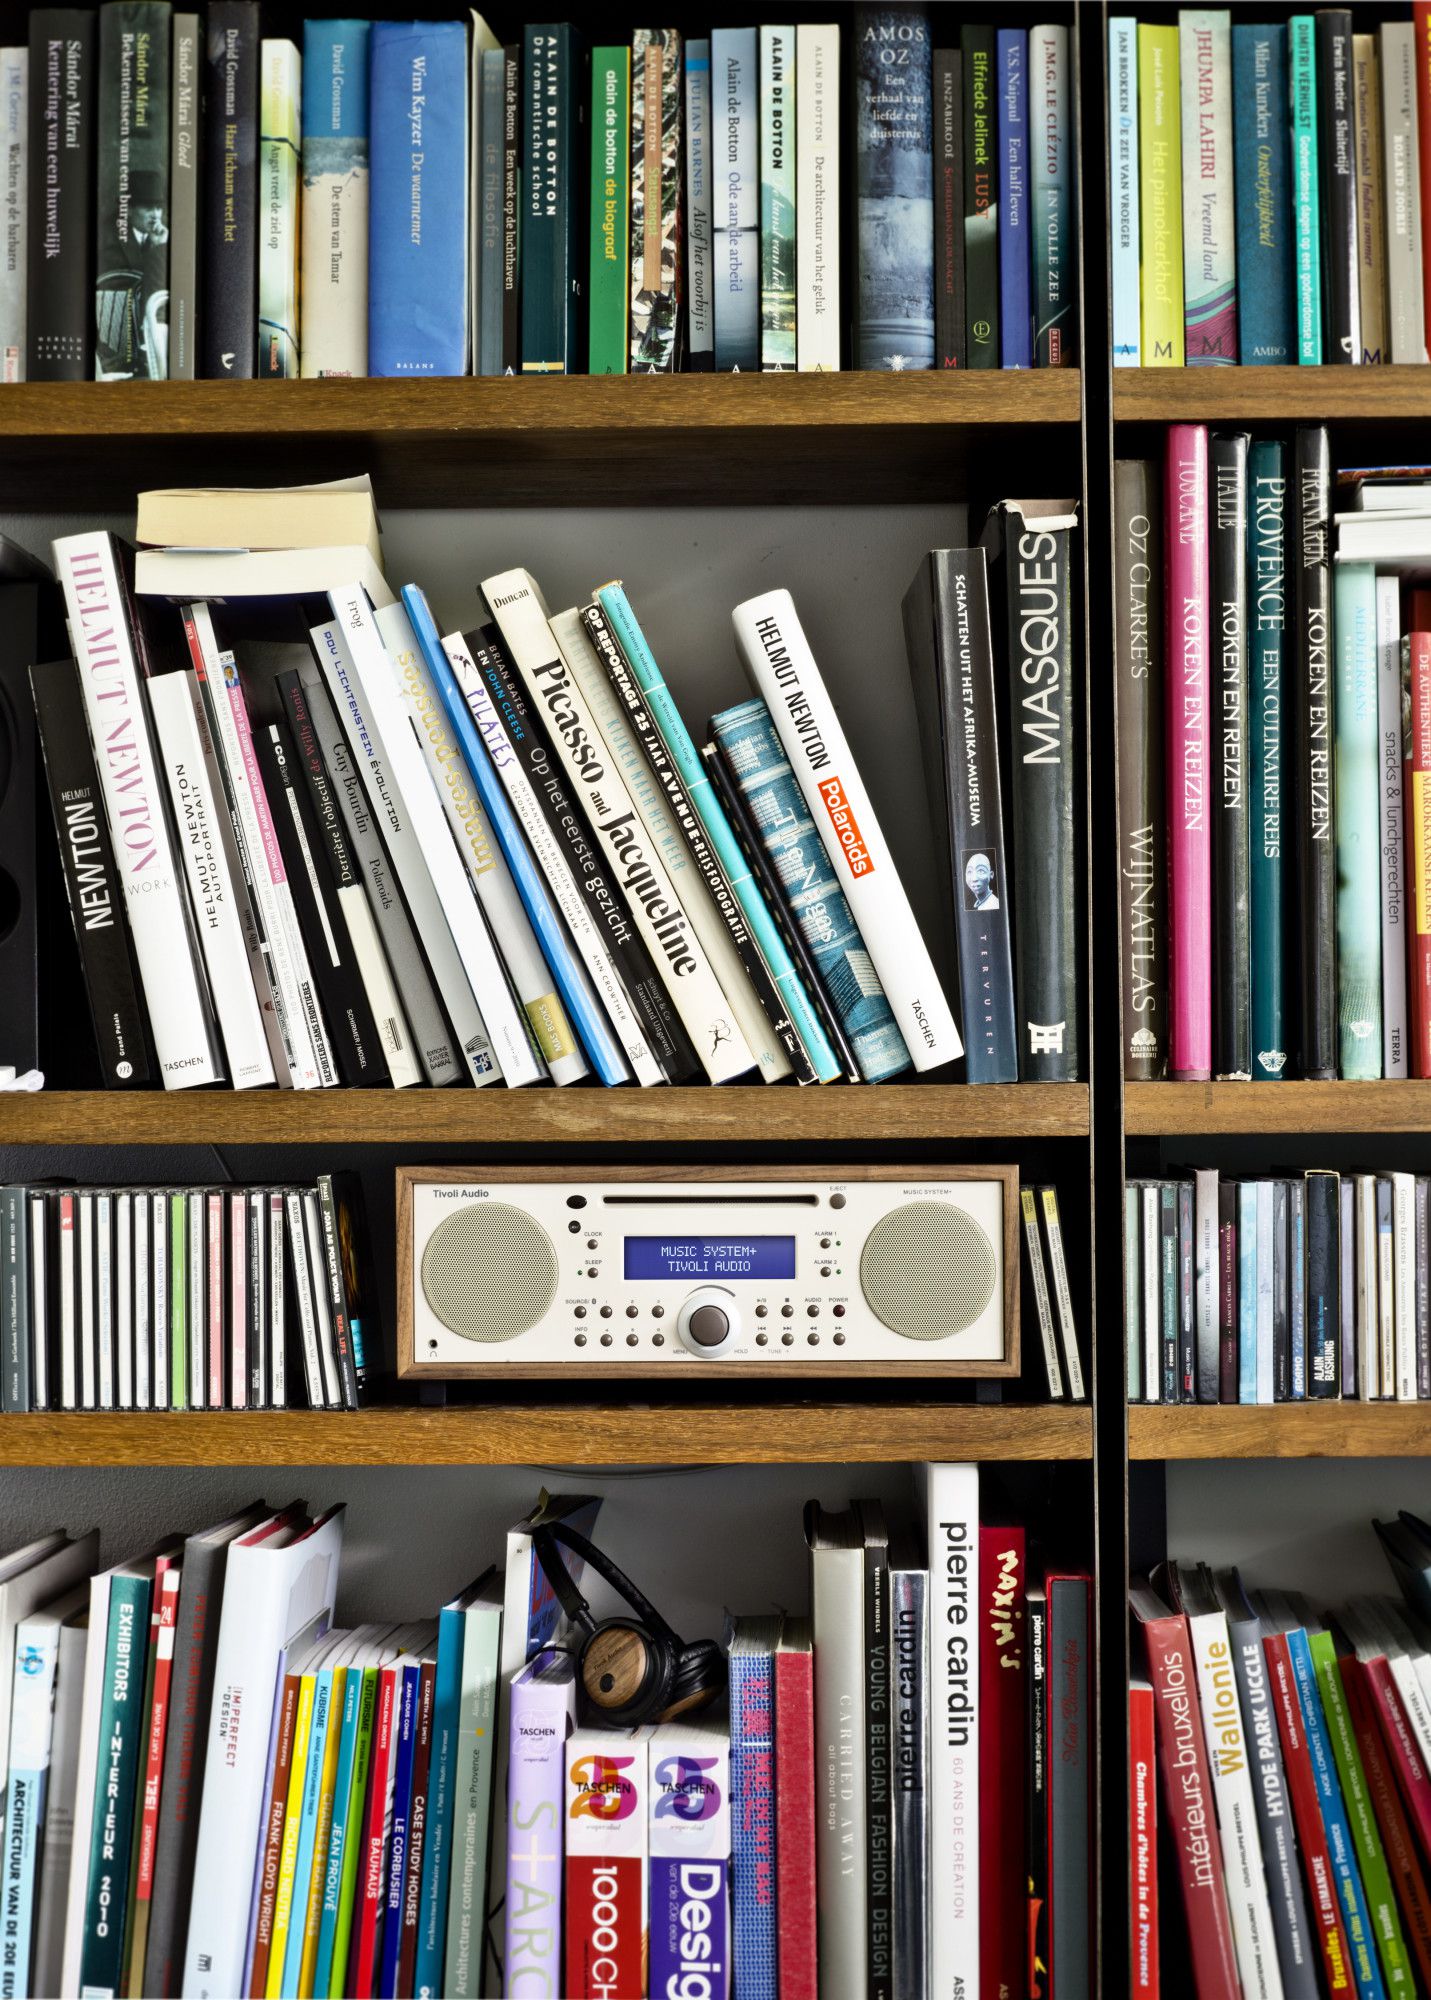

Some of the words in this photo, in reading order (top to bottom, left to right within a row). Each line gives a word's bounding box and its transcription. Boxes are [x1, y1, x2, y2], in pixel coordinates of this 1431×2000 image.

[332, 44, 344, 73] David
[533, 37, 543, 55] De
[863, 26, 924, 41] AMOS
[880, 49, 909, 64] OZ
[1007, 46, 1020, 69] V.S.
[46, 40, 62, 119] Kentering
[66, 40, 81, 98] Sándor
[178, 37, 191, 85] Sándor
[412, 56, 426, 92] Wim
[547, 37, 558, 96] ALAIN
[973, 52, 987, 109] Elfriede
[1197, 29, 1212, 106] JHUMPA
[1255, 41, 1269, 78] Milan
[178, 88, 191, 125] Márai
[332, 77, 344, 129] Grossman
[532, 62, 543, 159] romantische
[606, 71, 617, 104] alain
[1005, 72, 1021, 122] Naipaul
[1257, 82, 1271, 138] Kundera
[47, 124, 56, 151] van
[66, 102, 81, 148] Márai
[408, 96, 425, 146] Kayzer
[547, 107, 557, 128] DE
[605, 109, 617, 125] de
[974, 113, 988, 165] Jelinek
[47, 155, 56, 184] een
[177, 132, 191, 168] Gloed
[412, 153, 424, 171] De
[605, 129, 617, 174] botton
[1009, 138, 1021, 162] Een
[1200, 112, 1215, 179] LAHIRI
[331, 186, 342, 199] De
[532, 166, 542, 216] school
[546, 139, 556, 216] BOTTON
[605, 179, 617, 196] de
[975, 174, 989, 220] LUST
[1009, 166, 1022, 190] half
[1255, 145, 1274, 246] Onsterfelijkheid
[44, 188, 60, 259] huwelijk
[331, 203, 341, 227] stem
[410, 174, 422, 245] waarnemer
[603, 200, 617, 259] biograaf
[1009, 193, 1021, 226] leven
[1202, 192, 1216, 245] Vreemd
[331, 230, 339, 248] van
[331, 251, 342, 284] Tamar
[1202, 250, 1217, 281] land
[347, 600, 367, 628] Frog
[493, 589, 530, 608] Duncan
[955, 574, 970, 646] SCHATTEN
[958, 649, 971, 672] UIT
[1018, 533, 1060, 764] MASQUES
[1182, 597, 1203, 688] KOKEN
[960, 677, 972, 703] HET
[1263, 649, 1279, 692] EEN
[69, 551, 127, 707] HELMUT
[101, 718, 159, 873] NEWTON
[323, 631, 340, 656] ROY
[333, 661, 375, 757] LICHTENSTEIN
[371, 759, 402, 833] ÉVOLUTION
[466, 688, 516, 768] PILATES
[1183, 695, 1202, 729] EN
[332, 743, 354, 772] Guy
[526, 747, 552, 776] Op
[588, 608, 608, 630] OP
[599, 632, 640, 710] REPORTAGE
[632, 712, 650, 732] 25
[644, 736, 667, 767] JAAR
[661, 771, 748, 944] AVENUE-REISFOTOGRAFIE
[962, 707, 981, 826] AFRIKA-MUSEUM
[1263, 695, 1280, 809] CULINAIRE
[1384, 731, 1400, 782] snacks
[61, 791, 90, 801] HELMUT
[175, 764, 202, 844] NEWTON
[341, 776, 371, 834] Bourdin
[546, 779, 569, 810] het
[1183, 740, 1203, 831] REIZEN
[1388, 786, 1401, 800] &
[531, 657, 605, 783] Picasso
[589, 791, 613, 816] and
[603, 810, 701, 978] Jacqueline
[755, 616, 799, 691] HELMUT
[790, 692, 831, 770] NEWTON
[823, 781, 868, 874] Polaroids
[911, 998, 936, 1049] TASCHEN
[1262, 814, 1280, 858] REIS
[64, 802, 114, 929] NEWTON
[191, 784, 225, 902] AUTOPORTRAIT
[557, 815, 597, 872] eerste
[1384, 804, 1403, 925] lunchgerechten
[127, 878, 170, 897] WORK
[191, 855, 220, 928] HELMUT
[370, 859, 393, 910] Polaroids
[584, 876, 632, 945] gezicht
[1124, 823, 1156, 1012] WIJNATLAS
[163, 1055, 204, 1072] TASCHEN
[1392, 1027, 1400, 1064] TERRA
[433, 1190, 458, 1198] Tivoli
[661, 1247, 697, 1257] MUSIC
[703, 1246, 757, 1257] SYSTEM+
[669, 1261, 709, 1272] TIVOLI
[715, 1261, 751, 1272] AUDIO
[336, 1315, 345, 1334] REAL
[338, 1337, 347, 1355] LIFE
[940, 1522, 973, 1625] pierre
[113, 1603, 134, 1701] EXHIBITORS
[1242, 1645, 1268, 1702] UCCLE
[869, 1646, 886, 1711] YOUNG
[947, 1636, 974, 1746] cardin
[316, 1686, 328, 1728] KUBISME
[361, 1679, 374, 1732] FUTURISME
[1159, 1653, 1198, 1766] bruxellois
[1207, 1642, 1244, 1776] Wallonie
[519, 1728, 555, 1736] TASCHEN
[840, 1695, 854, 1801] CARRIED
[1250, 1707, 1277, 1759] PARK
[576, 1782, 631, 1794] TASCHEN
[661, 1782, 715, 1794] TASCHEN
[870, 1725, 887, 1802] BELGIAN
[952, 1757, 963, 1776] 60
[412, 1796, 424, 1829] CASE
[953, 1781, 964, 1811] ANS
[1258, 1763, 1284, 1816] HYDE
[270, 1801, 283, 1845] FRANK
[330, 1823, 343, 1853] JEAN
[394, 1818, 404, 1832] LE
[841, 1817, 854, 1879] AWAY
[953, 1816, 964, 1835] DE
[1180, 1774, 1214, 1887] intérieurs
[264, 1849, 277, 1889] LLOYD
[367, 1837, 381, 1898] BAUHAUS
[389, 1837, 403, 1908] CORBUSIER
[409, 1832, 422, 1872] STUDY
[872, 1815, 888, 1897] FASHION
[325, 1858, 342, 1911] PROUVÉ
[406, 1875, 420, 1925] HOUSES
[953, 1841, 967, 1919] CRÉATION
[97, 1876, 110, 1937] 2010
[258, 1893, 273, 1944] WRIGHT
[872, 1909, 889, 1977] DESIGN
